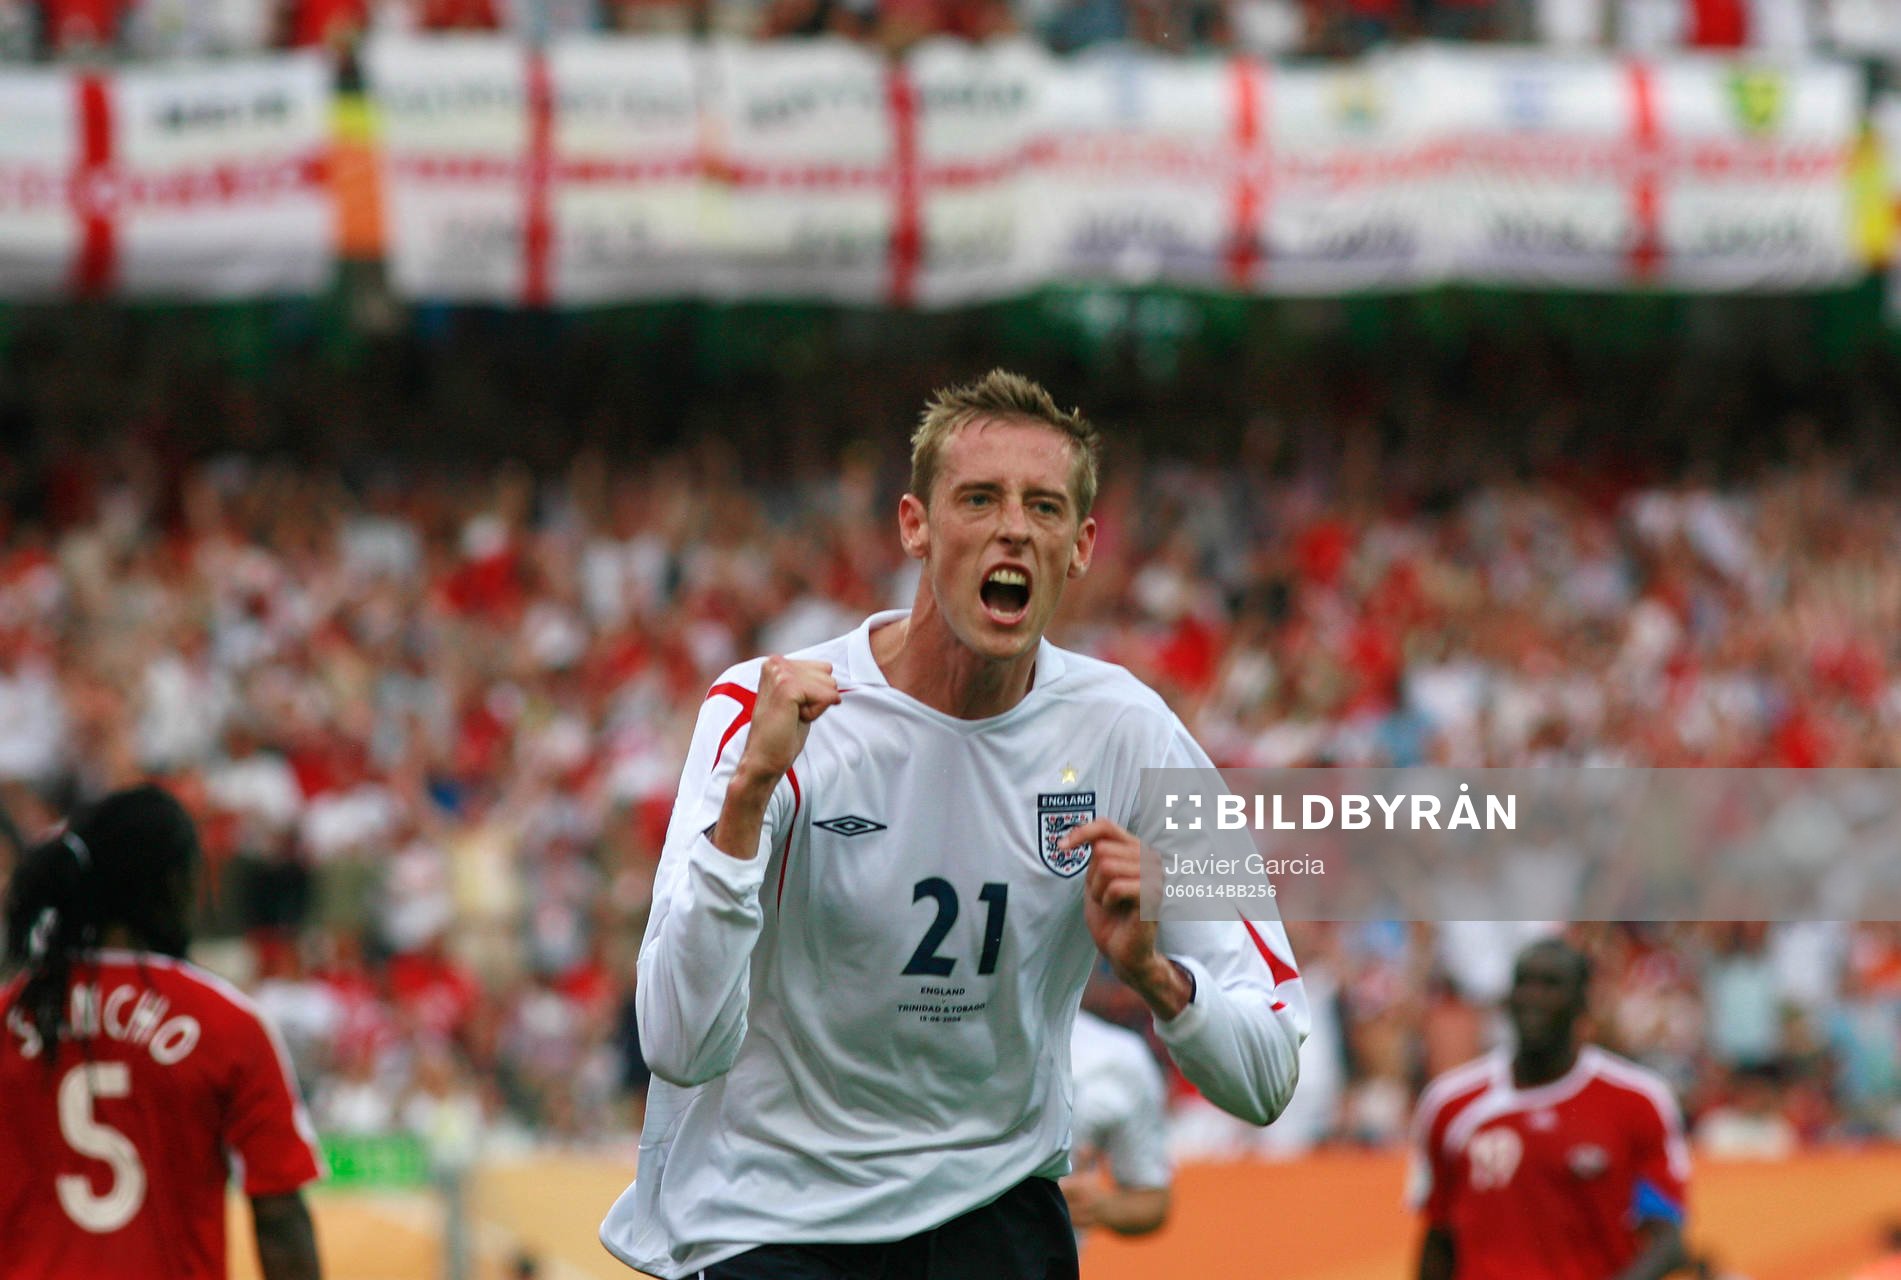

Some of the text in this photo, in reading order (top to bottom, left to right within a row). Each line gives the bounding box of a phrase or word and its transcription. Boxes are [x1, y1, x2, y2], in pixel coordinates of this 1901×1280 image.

[1041, 794, 1093, 807] ENGLAND
[900, 876, 1008, 977] 21
[897, 1003, 986, 1014] TRINIDAD & TOBAGO
[920, 986, 966, 997] ENGLAND
[6, 982, 202, 1066] SNCHO
[57, 1062, 147, 1234] 5
